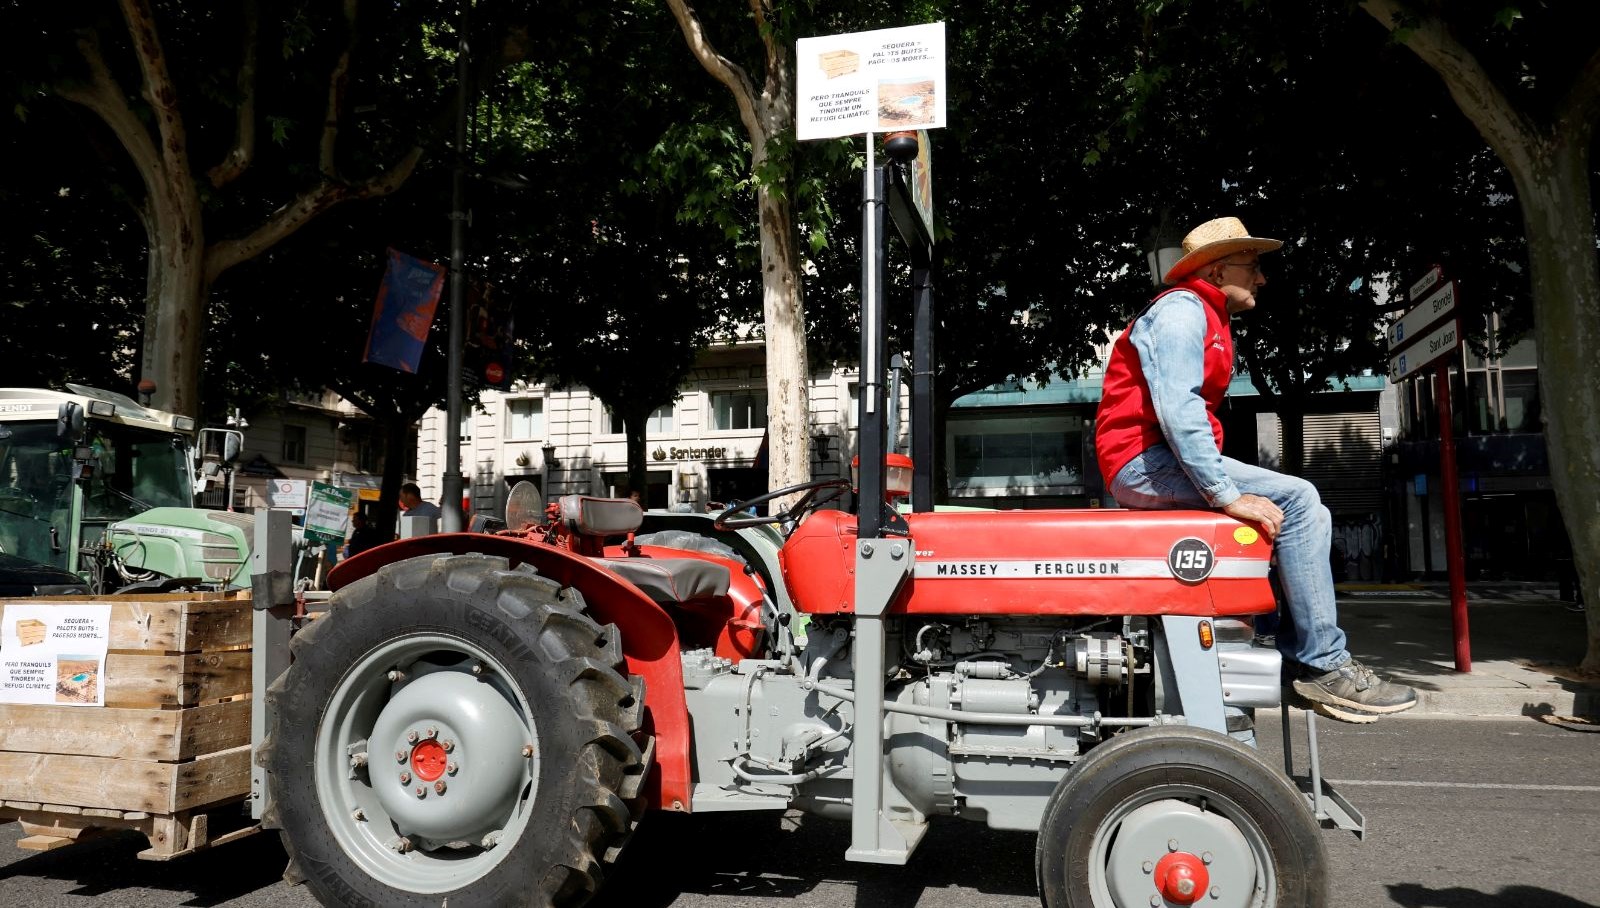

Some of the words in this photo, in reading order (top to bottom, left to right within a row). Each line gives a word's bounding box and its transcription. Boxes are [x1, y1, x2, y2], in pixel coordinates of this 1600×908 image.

[881, 41, 915, 50] SEQUERA
[901, 47, 923, 56] BUITS
[868, 57, 900, 65] PAGEOS
[831, 88, 870, 99] TRANQUILS
[834, 96, 863, 106] SEMPRE
[819, 106, 850, 115] TINDREM
[851, 103, 862, 111] UN
[837, 109, 870, 120] CLIMATIC
[1429, 336, 1441, 354] Sant
[1442, 330, 1455, 348] Joan
[670, 445, 726, 460] Santander
[914, 549, 935, 557] wer
[1175, 550, 1207, 569] 135
[937, 565, 998, 575] MASSEY
[1035, 564, 1120, 575] FERGUSON
